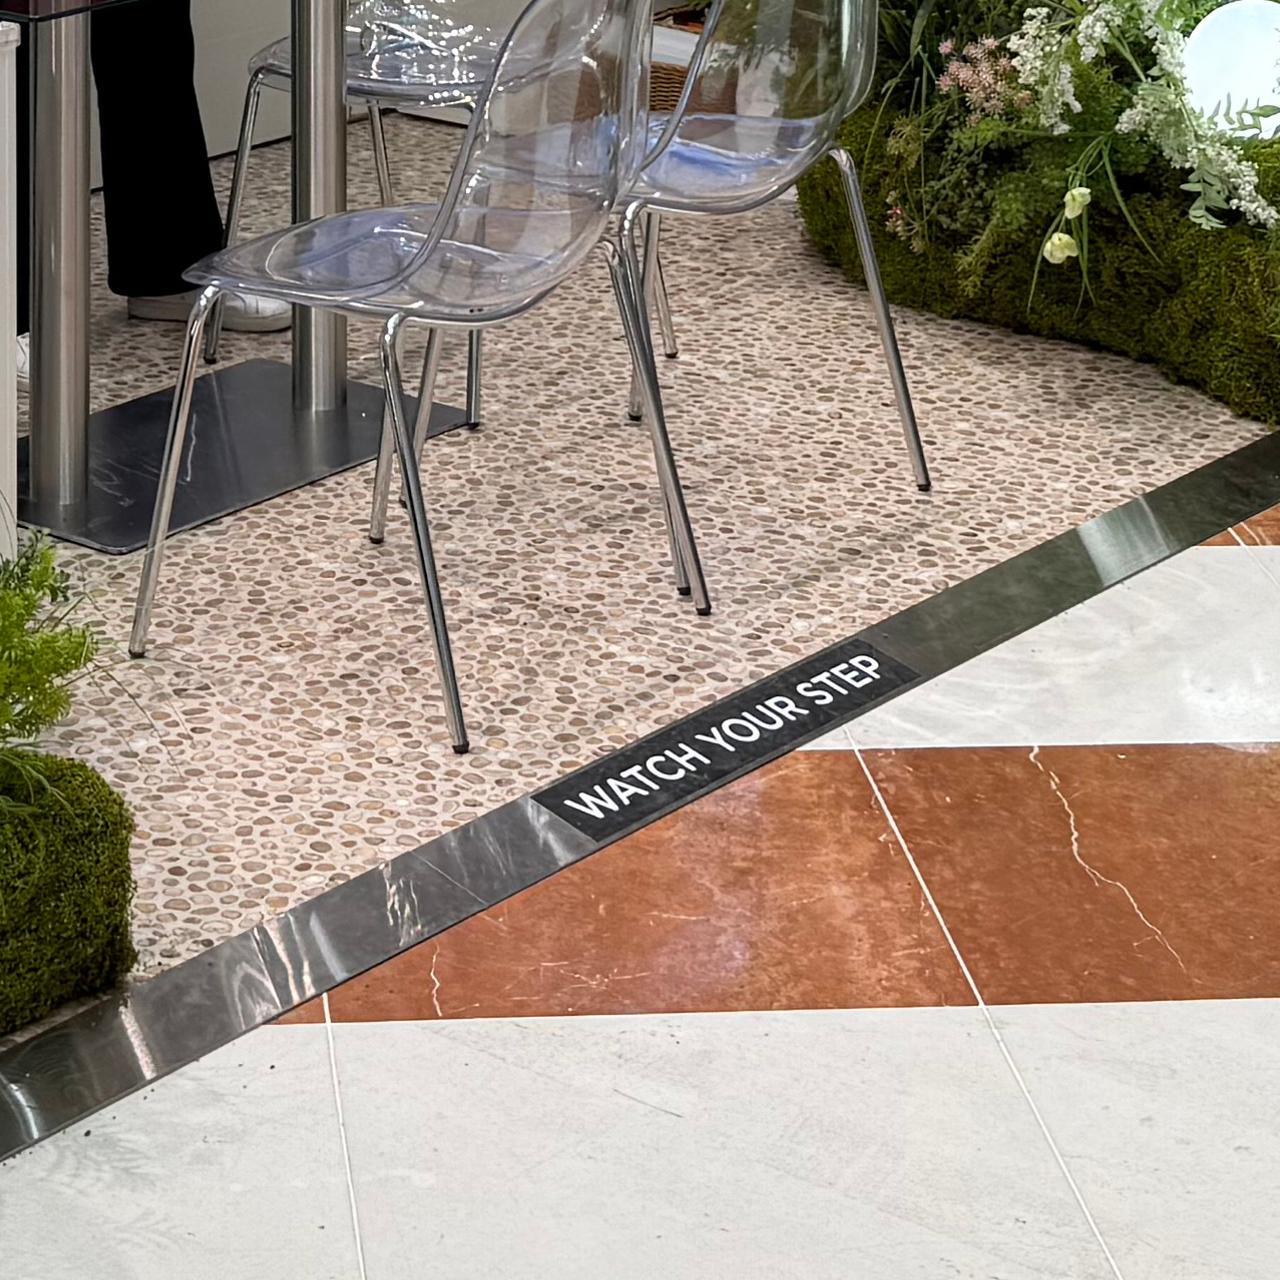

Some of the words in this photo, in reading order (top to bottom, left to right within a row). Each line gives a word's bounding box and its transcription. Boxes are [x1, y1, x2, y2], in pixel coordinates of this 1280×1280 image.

[563, 742, 711, 820] WATCH
[695, 695, 810, 753] YOUR
[796, 653, 882, 706] STEP
